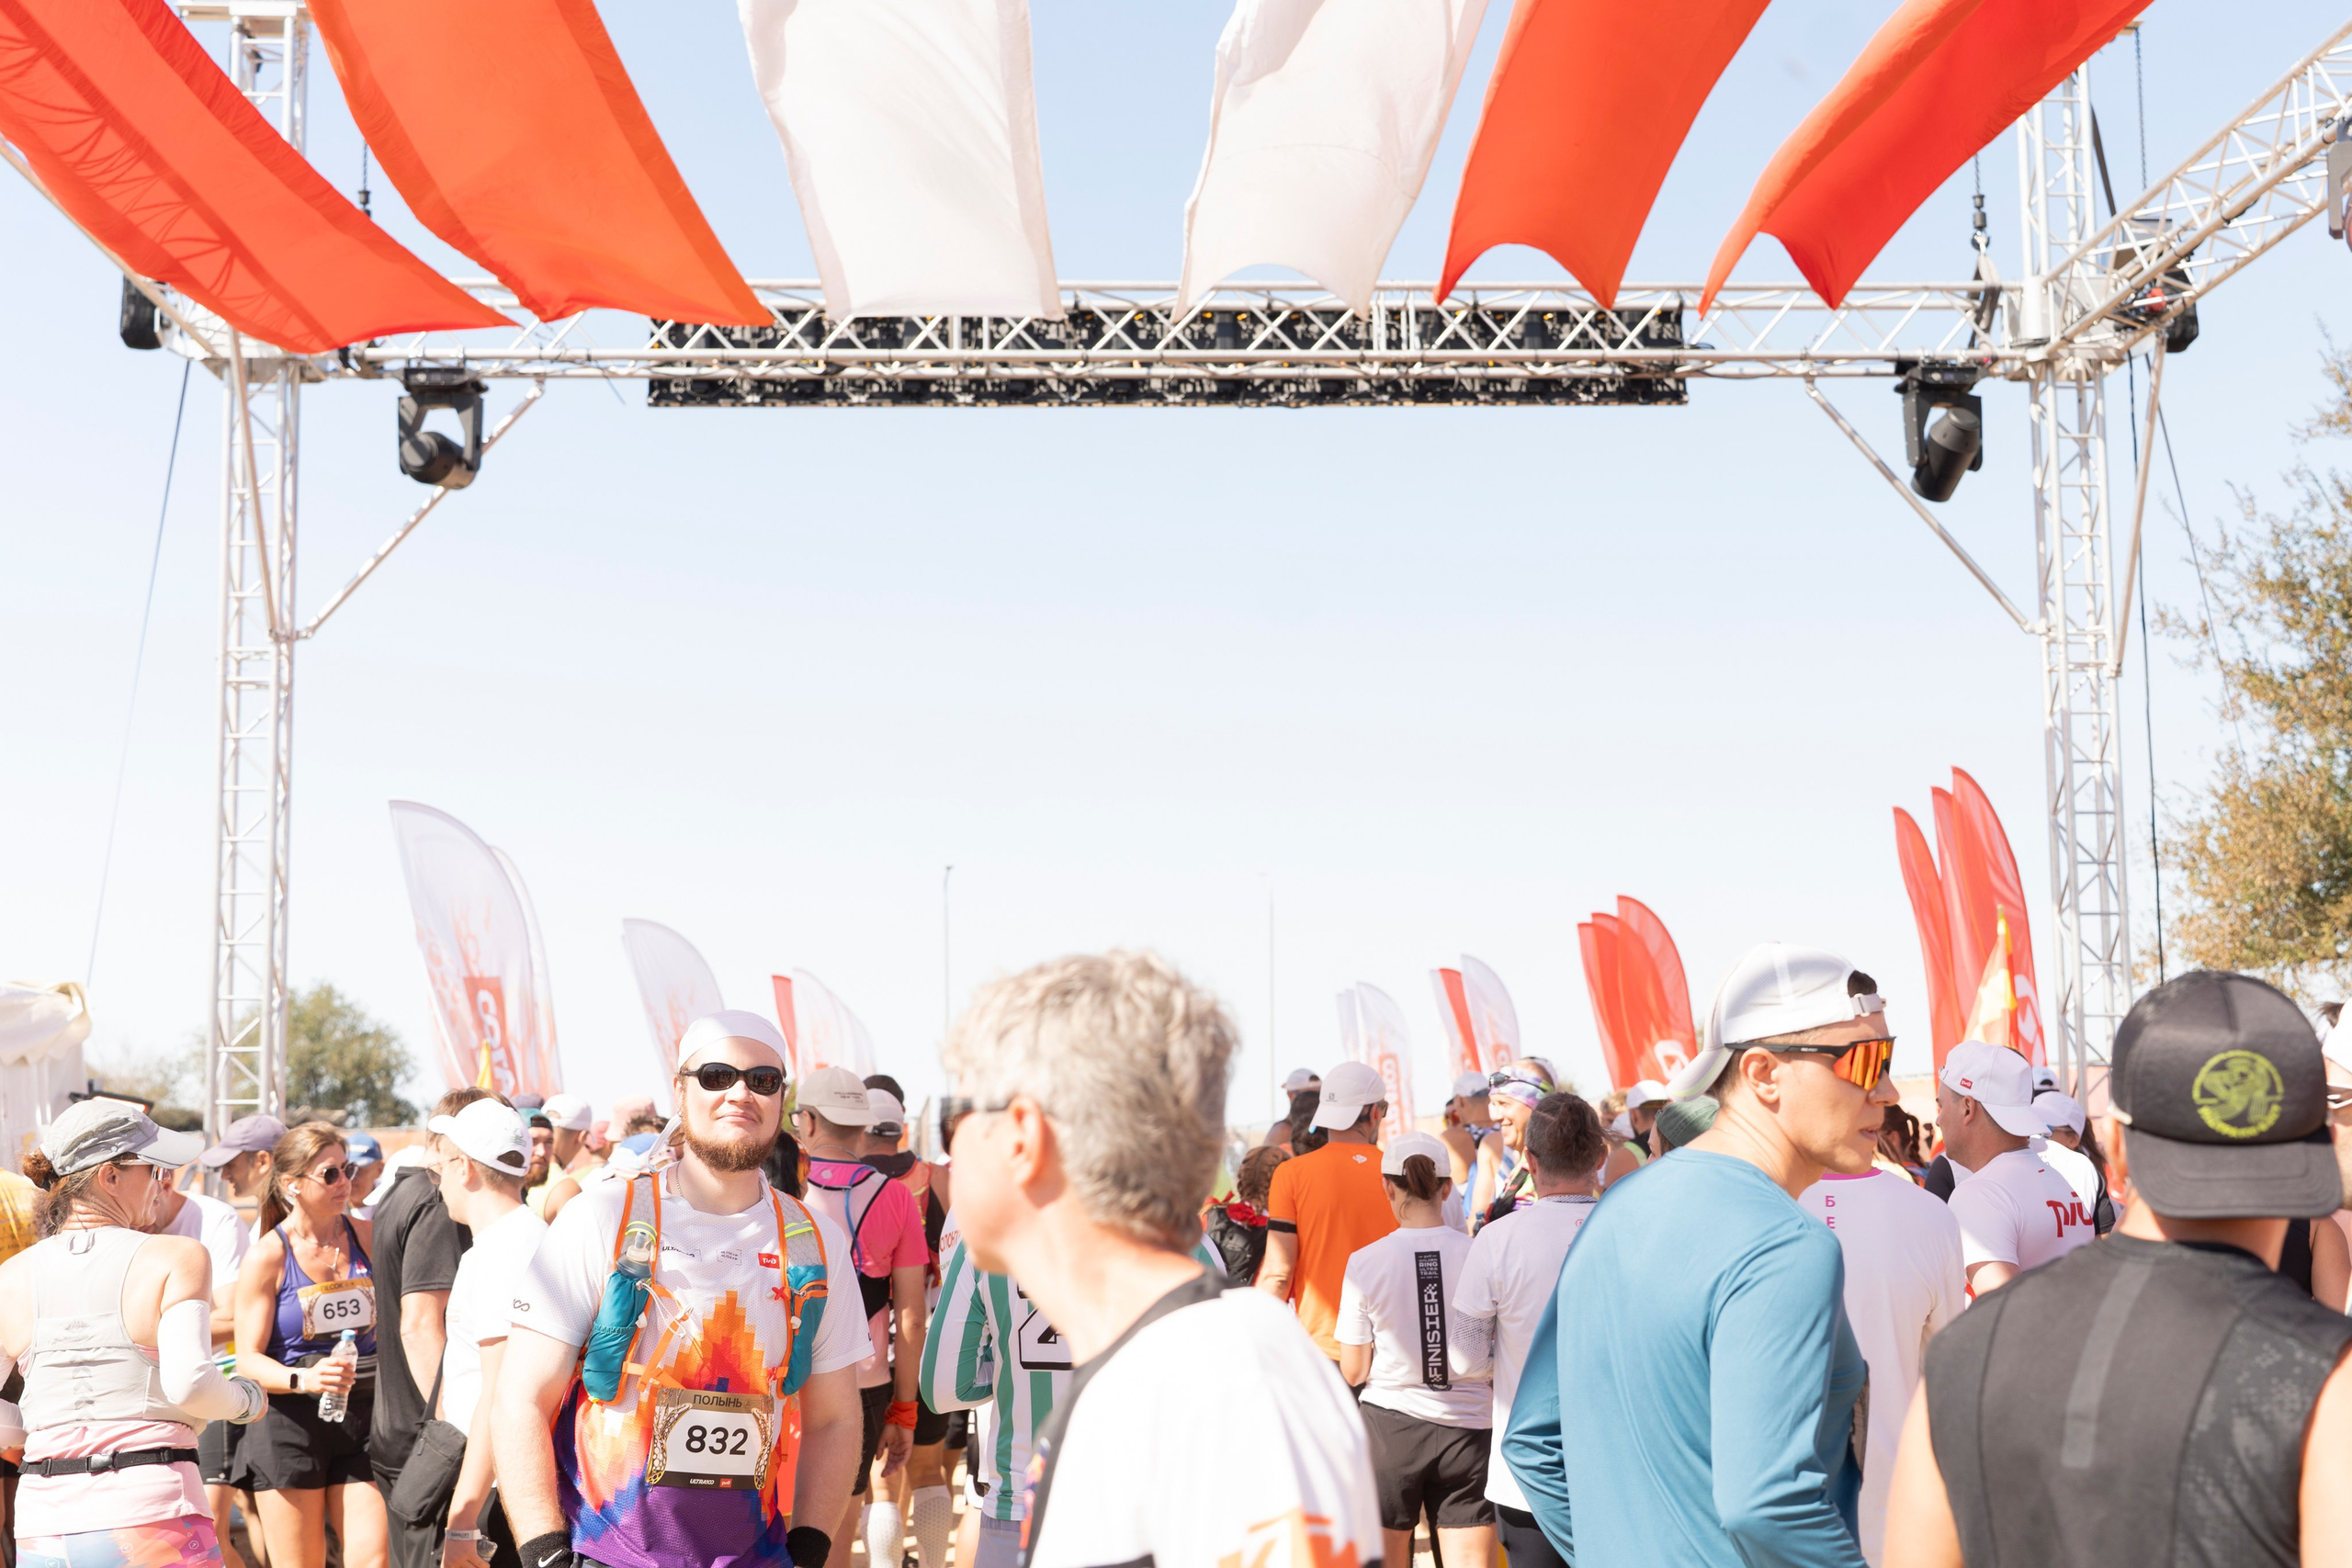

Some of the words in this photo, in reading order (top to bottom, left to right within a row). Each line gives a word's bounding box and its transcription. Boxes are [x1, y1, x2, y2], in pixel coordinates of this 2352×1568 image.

[322, 1298, 361, 1320] 653
[693, 1393, 742, 1408] ПОЛЫНЬ
[685, 1425, 749, 1456] 832
